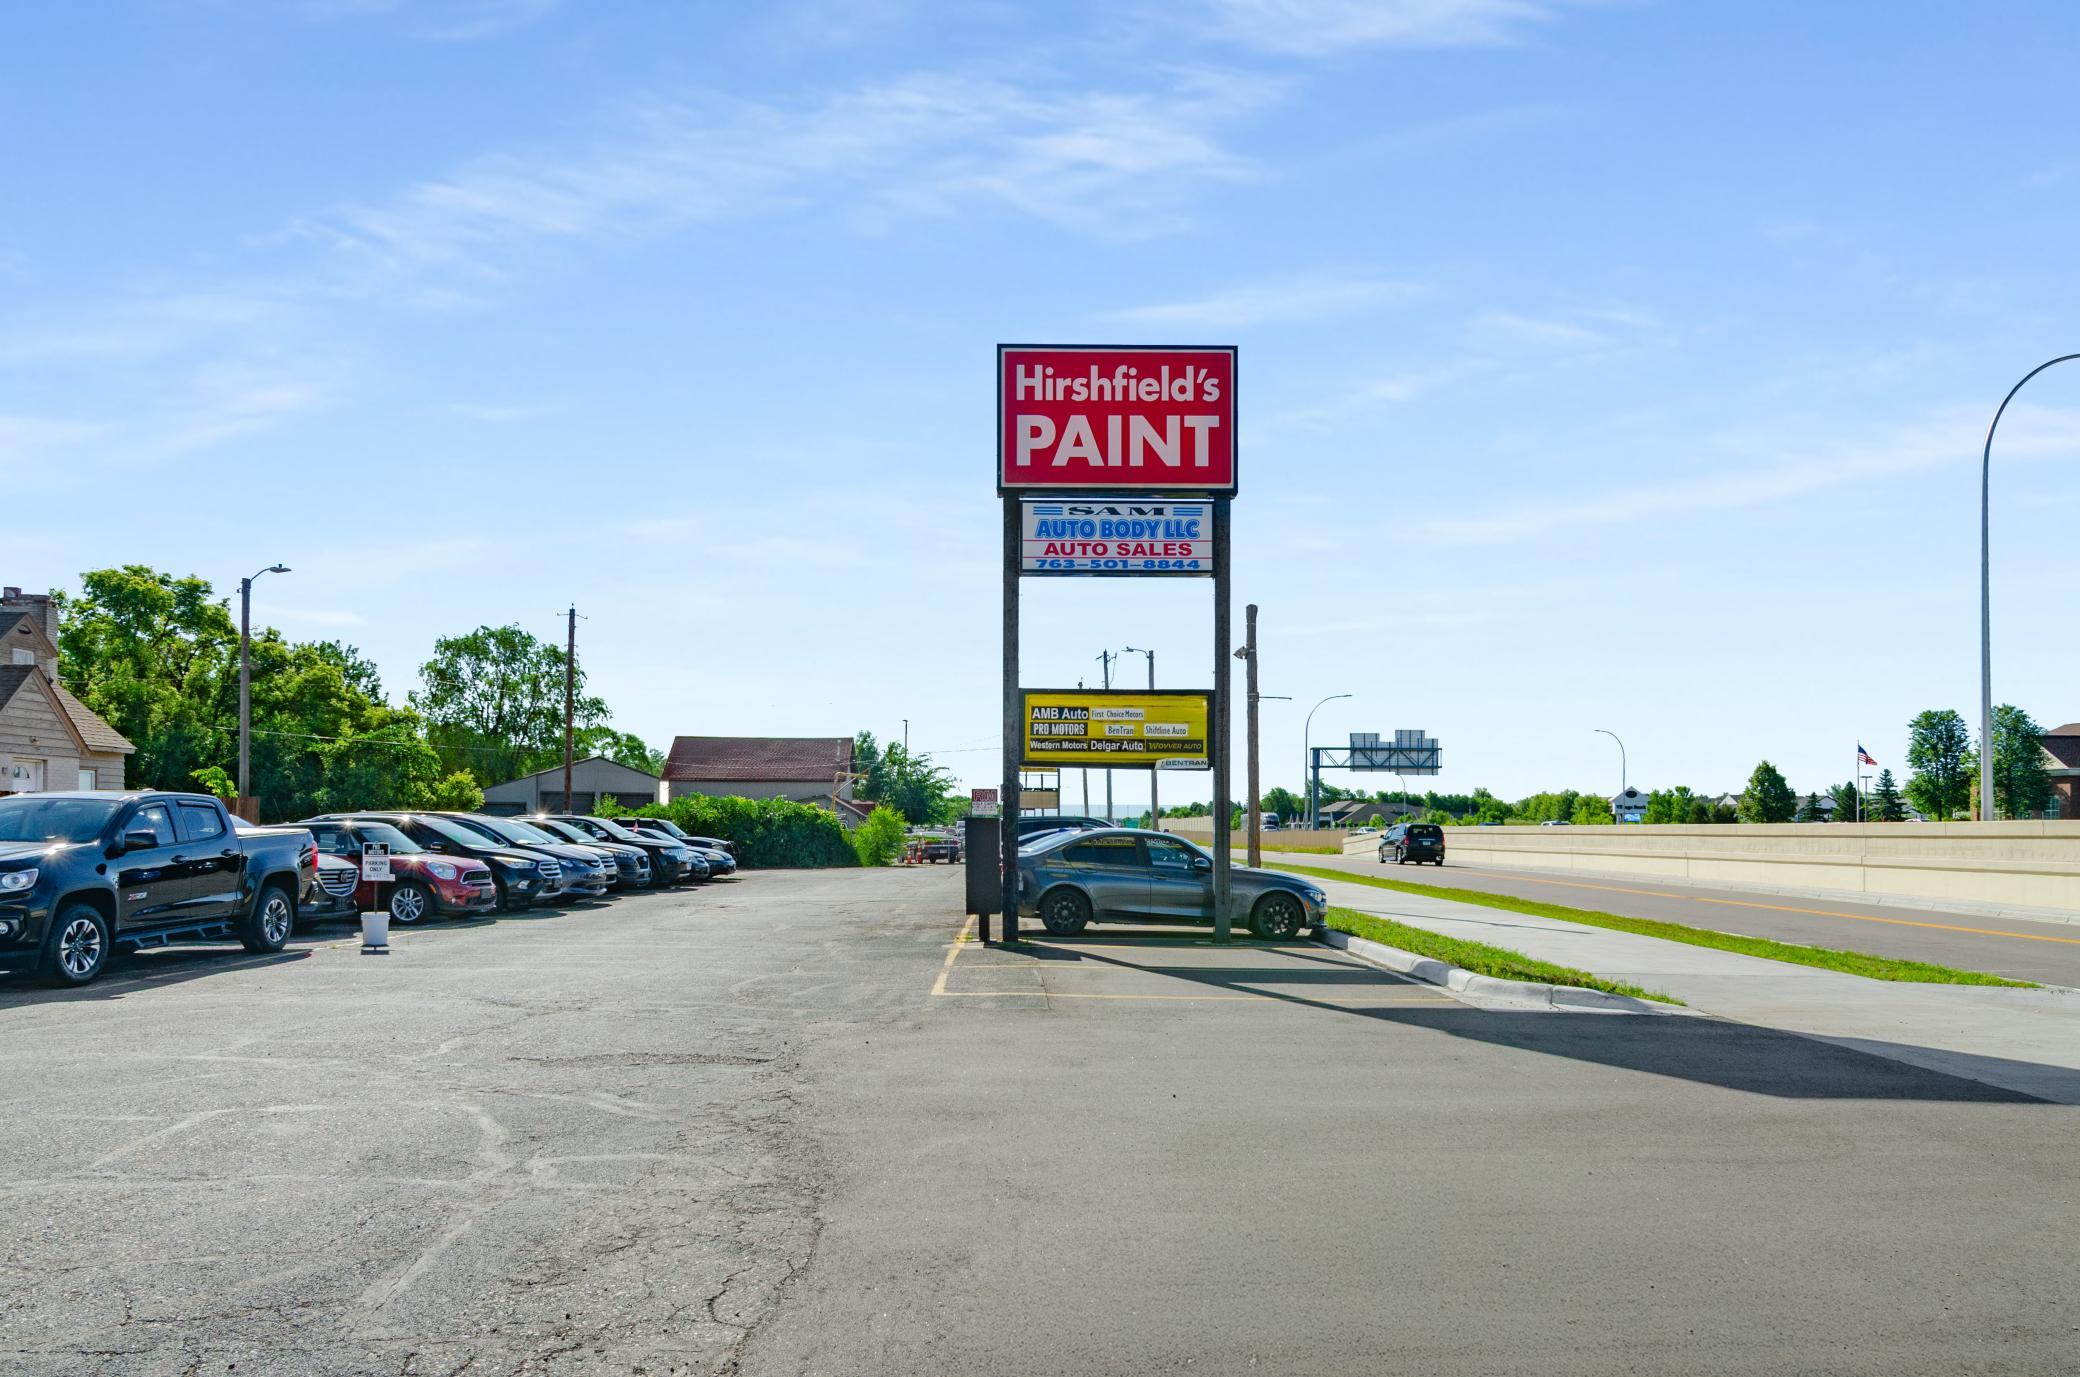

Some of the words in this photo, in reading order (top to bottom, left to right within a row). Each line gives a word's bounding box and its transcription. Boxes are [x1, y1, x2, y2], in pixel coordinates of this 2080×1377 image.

[1016, 364, 1220, 402] Hirshfield's
[1016, 414, 1220, 467] PAINT
[1068, 506, 1167, 516] SAM
[1035, 519, 1097, 539] AUTO
[1100, 519, 1162, 539] BODY
[1163, 520, 1200, 539] LLC
[1043, 542, 1109, 556] AUTO
[1116, 542, 1193, 556] SALES
[1035, 559, 1200, 569] 763-501-8844
[1032, 707, 1060, 719] AMB
[1061, 708, 1089, 720] Auto
[1091, 710, 1104, 718] First
[1106, 710, 1124, 718] Choice
[1124, 710, 1144, 718] Motors
[1033, 723, 1050, 735] PRO
[1051, 723, 1085, 735] MOTORS
[1107, 725, 1134, 735] BenTran
[1171, 725, 1187, 735] Auto
[1030, 740, 1060, 749] Western
[1061, 740, 1088, 750] Motors
[1090, 740, 1120, 752] Delgar
[1121, 741, 1144, 751] Auto
